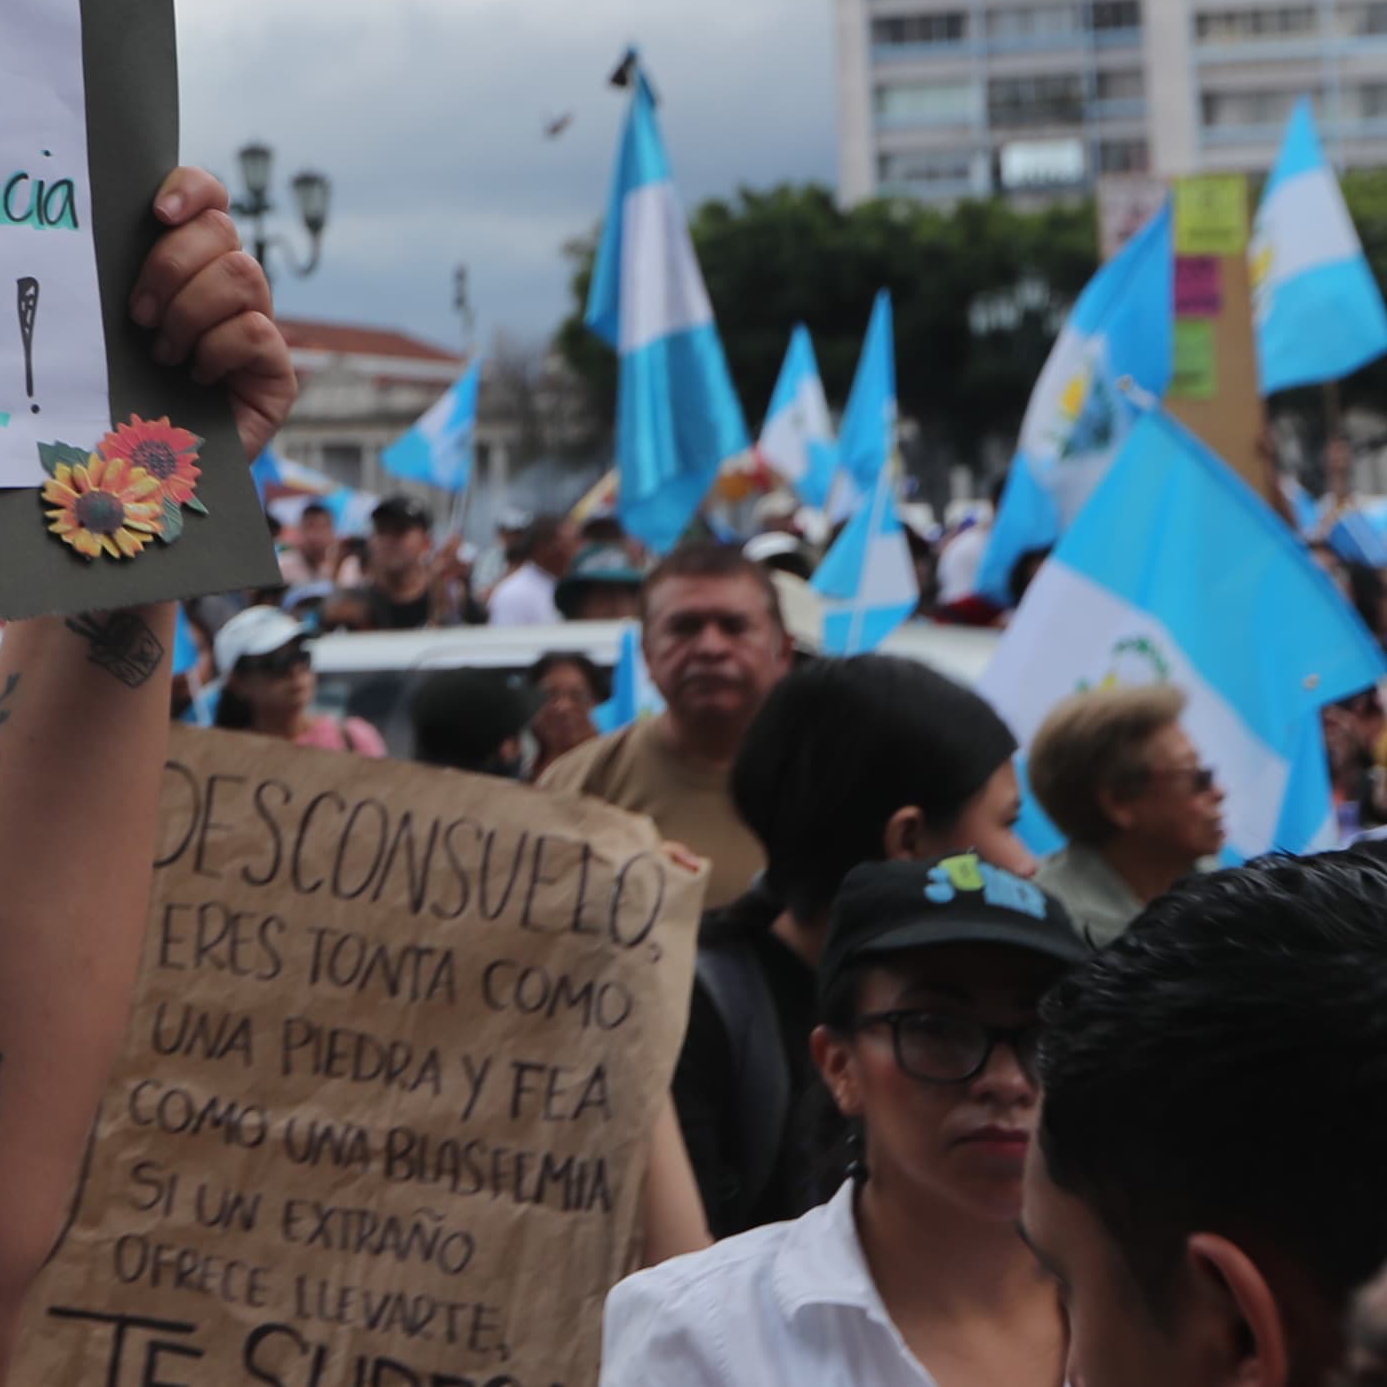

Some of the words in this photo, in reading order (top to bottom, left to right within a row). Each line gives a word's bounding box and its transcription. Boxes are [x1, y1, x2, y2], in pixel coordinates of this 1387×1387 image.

[157, 902, 285, 981] ERES
[308, 926, 456, 1005] TONTA
[482, 959, 633, 1030] COMO
[151, 1002, 253, 1067] UNA
[281, 1017, 443, 1096] PIEDRA
[460, 1054, 490, 1121] Y
[510, 1060, 612, 1121] FEA
[129, 1078, 267, 1149] COMO
[285, 1116, 372, 1169] UNA
[383, 1126, 613, 1214] BLASFEMIA
[115, 1233, 271, 1308] OFRECE
[129, 1160, 177, 1218] SI
[196, 1183, 262, 1232] UN
[282, 1199, 475, 1275] EXTRAÑO
